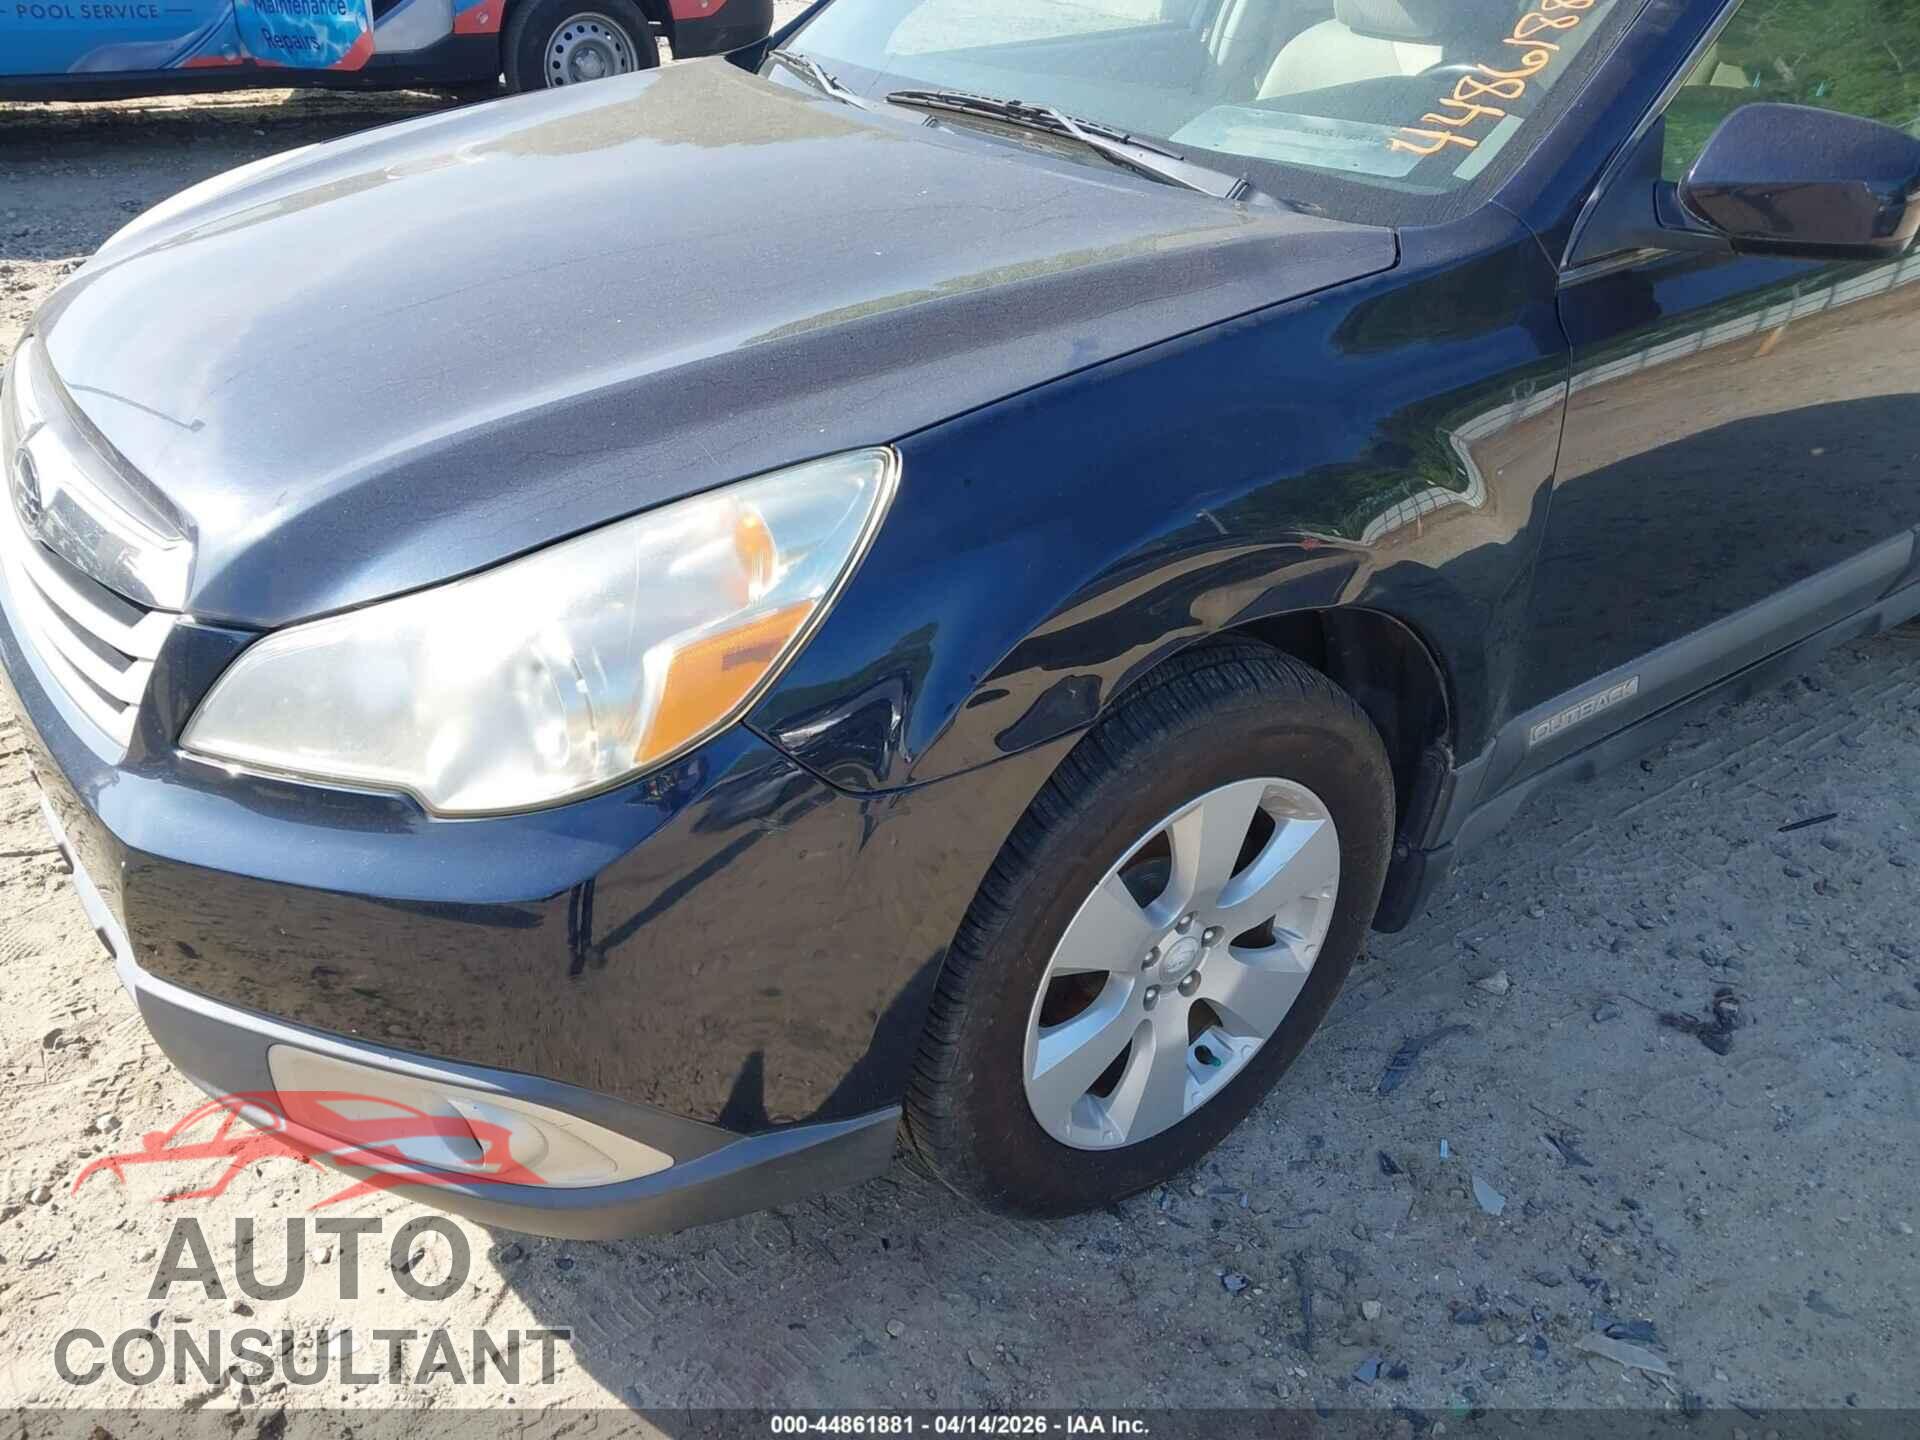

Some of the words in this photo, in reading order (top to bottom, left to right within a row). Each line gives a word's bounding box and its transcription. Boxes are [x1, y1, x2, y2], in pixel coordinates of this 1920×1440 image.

[16, 4, 75, 19] POOL
[80, 4, 160, 19] SERVICE
[253, 0, 347, 16] Maintenance
[262, 27, 321, 55] Repairs
[1532, 677, 1637, 743] OUTBACK
